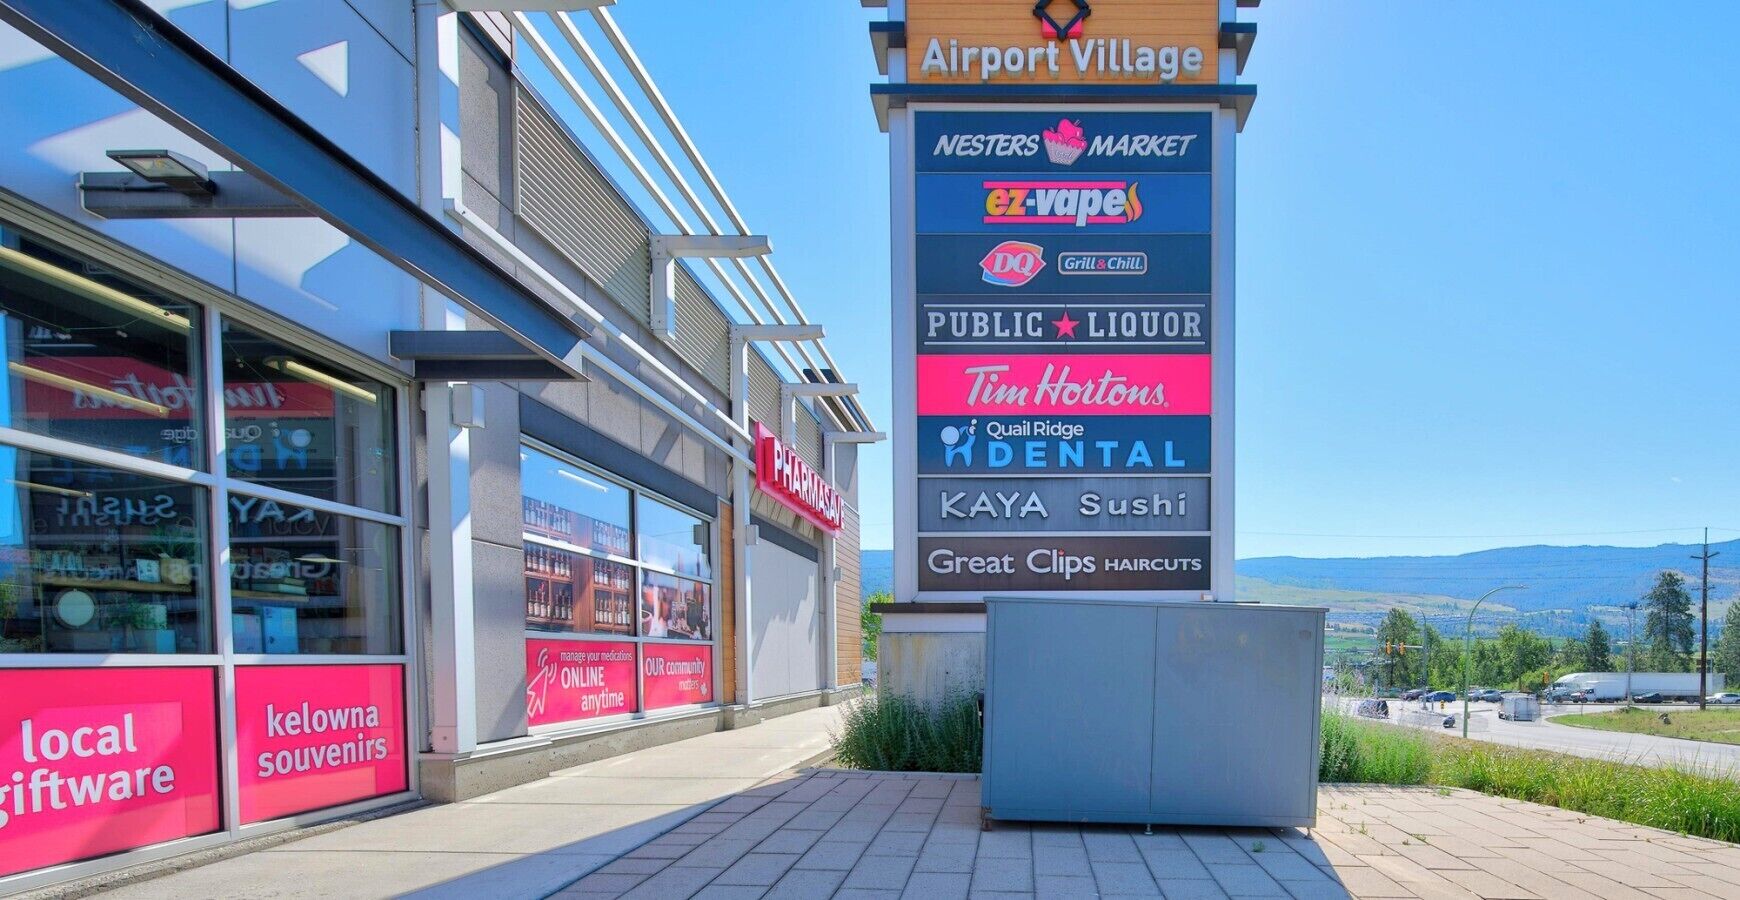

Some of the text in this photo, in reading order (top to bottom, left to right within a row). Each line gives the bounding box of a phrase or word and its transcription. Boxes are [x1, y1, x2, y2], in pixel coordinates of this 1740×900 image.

[920, 38, 1204, 82] Airport Village
[933, 134, 1198, 157] NESTERS MARKET
[985, 187, 1126, 227] ez-vape
[991, 252, 1035, 276] DQ
[927, 311, 1202, 338] PUBLIC LIQUOR
[964, 362, 1167, 407] Tim Hortons
[986, 419, 1085, 440] Quail Ridge
[988, 440, 1186, 468] DENTAL
[941, 491, 1187, 519] KAYA Sushi
[928, 548, 1203, 580] Great Clips HAIRCUTS
[560, 650, 633, 664] manage your medications
[645, 657, 706, 678] OUR community
[560, 666, 605, 689] ONLINE
[581, 689, 625, 714] anytime
[266, 702, 380, 738] kelowna
[20, 713, 138, 763] local
[257, 732, 389, 778] souvenirs
